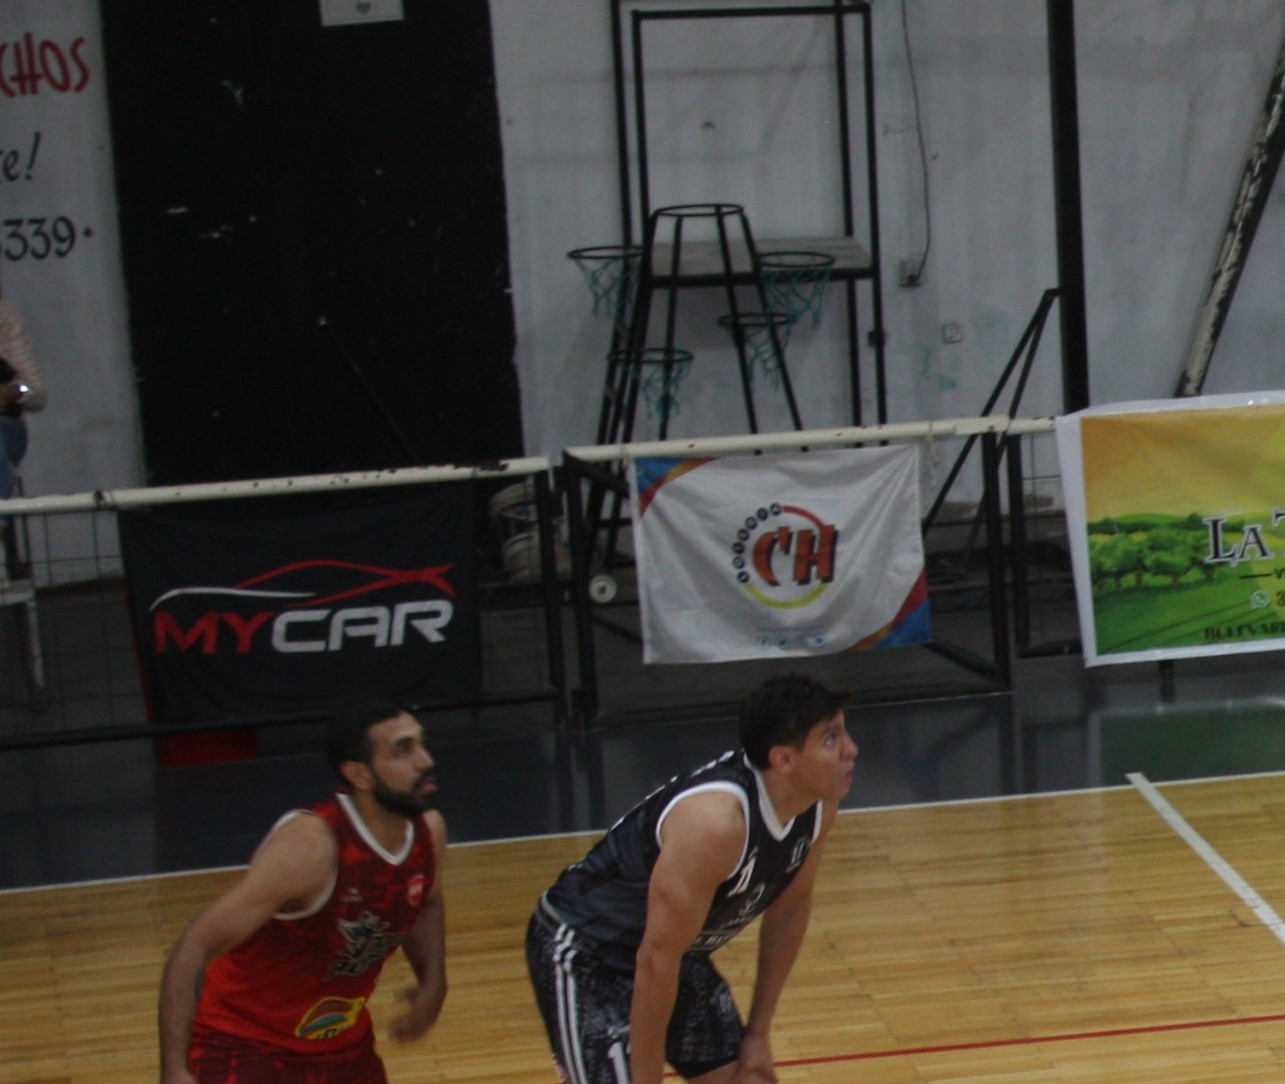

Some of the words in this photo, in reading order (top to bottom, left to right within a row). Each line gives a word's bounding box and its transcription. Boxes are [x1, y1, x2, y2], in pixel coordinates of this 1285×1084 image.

[0, 33, 90, 98] CHOS
[1205, 517, 1272, 562] LA
[153, 599, 454, 654] MYCAR
